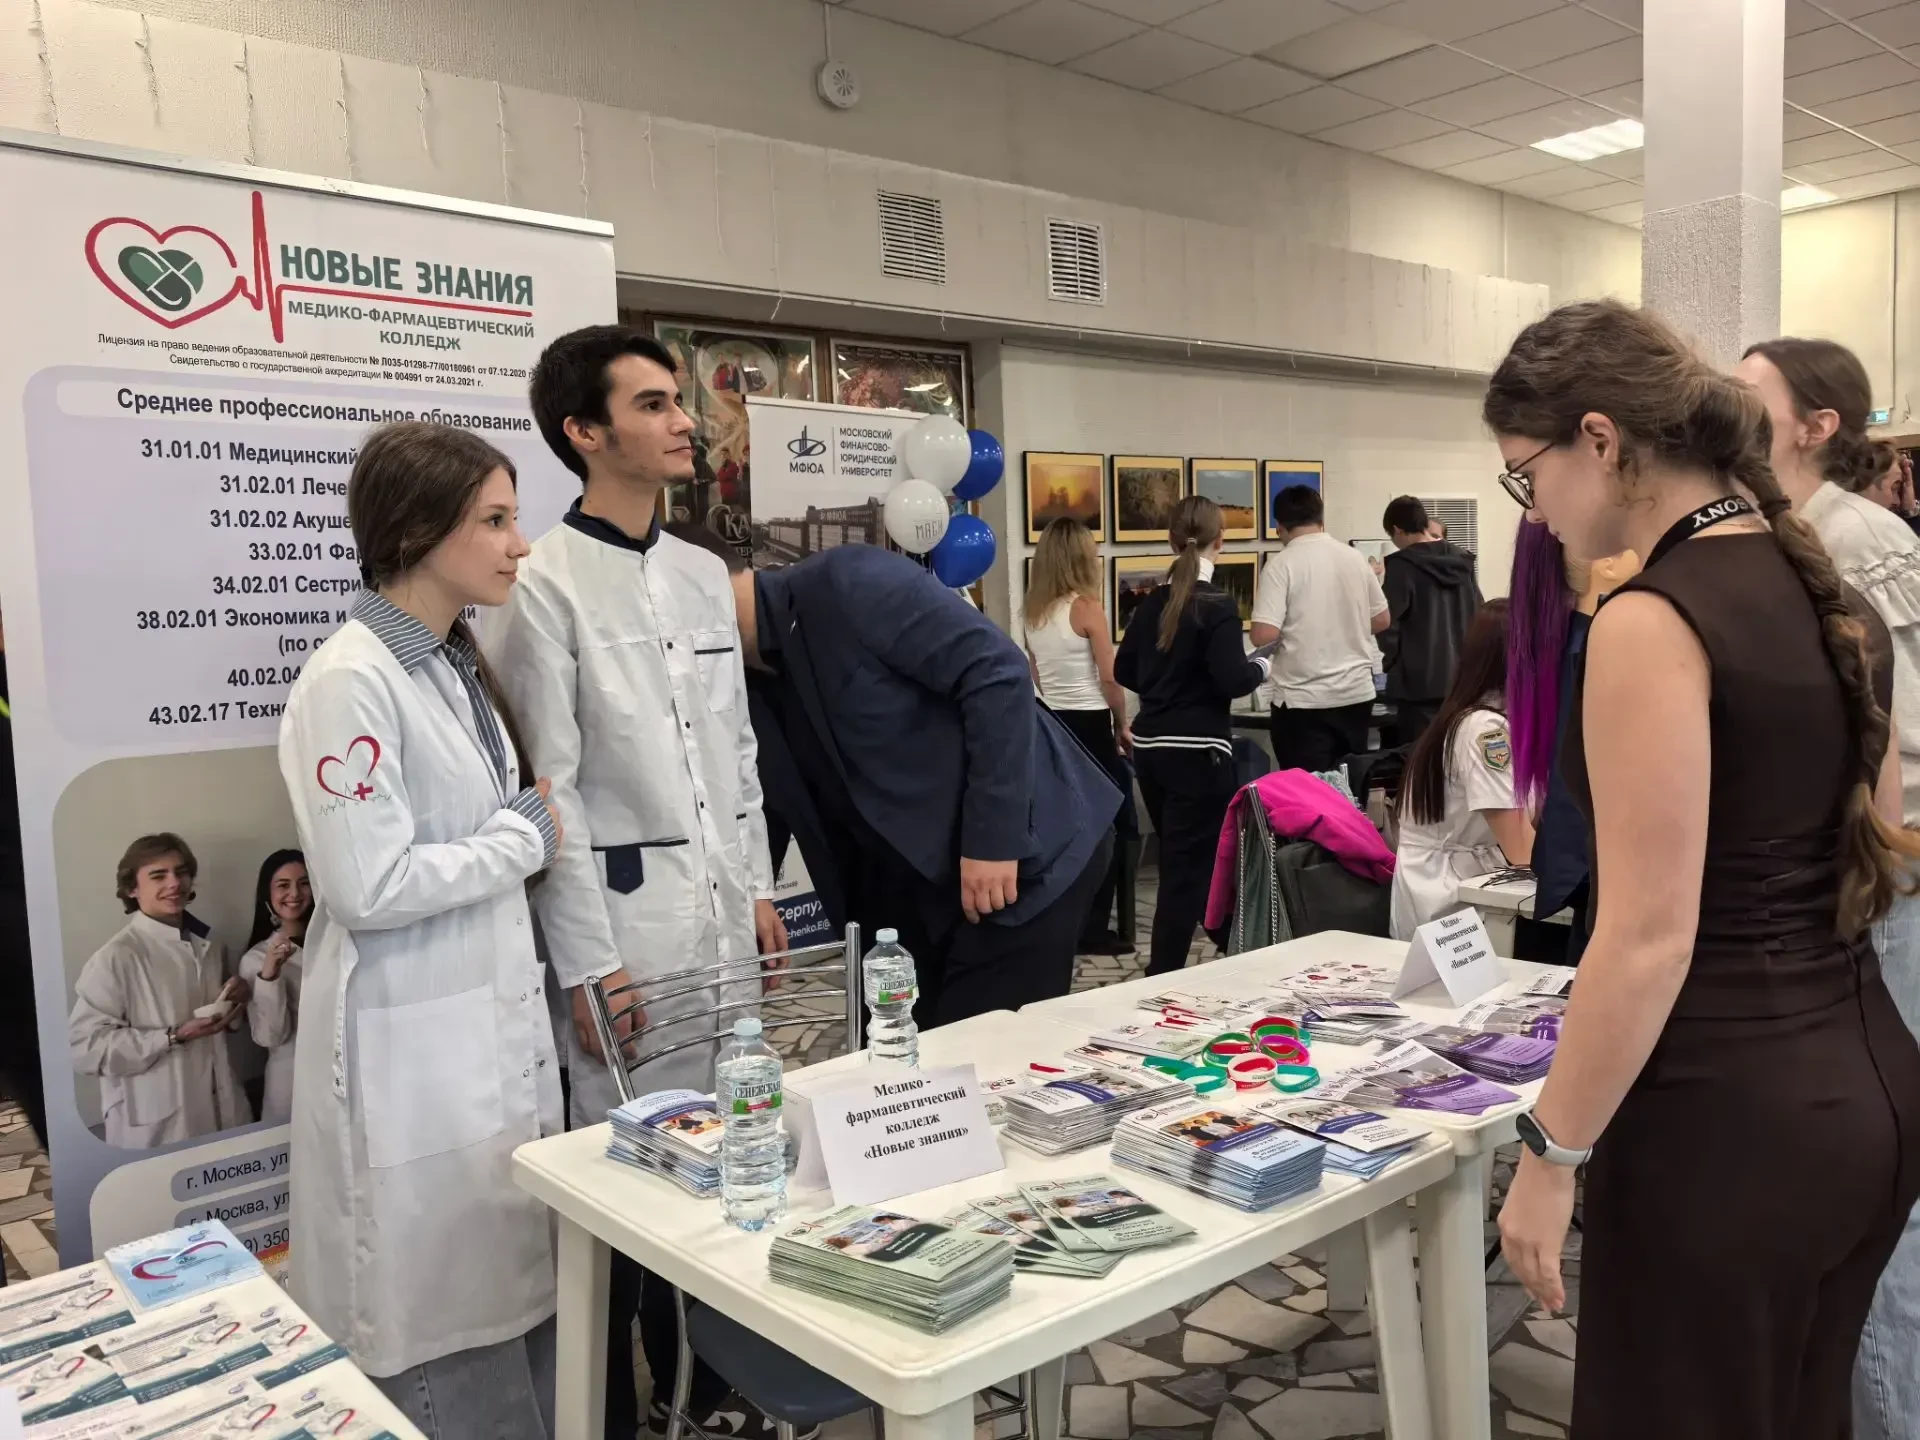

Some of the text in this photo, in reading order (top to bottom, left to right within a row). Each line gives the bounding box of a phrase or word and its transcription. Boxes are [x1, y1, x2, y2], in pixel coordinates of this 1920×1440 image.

[280, 245, 534, 306] НОВЫЕ ЗНАНИЯ
[288, 300, 535, 339] МЕДИКО-ФАРМАЦЕВТИЧЕСКИЙ
[380, 330, 462, 350] КОЛЛЕДЖ
[98, 333, 145, 347] Лицензия
[147, 339, 160, 348] на
[161, 340, 190, 352] право
[191, 343, 231, 354] ведения
[232, 344, 308, 361] образовательной
[310, 352, 368, 366] деятельности
[369, 356, 380, 366] №
[488, 366, 527, 378] 07.12.2020
[170, 353, 240, 368] Свидетельство
[250, 362, 323, 375] государственной
[324, 366, 382, 380] аккредитации
[383, 370, 393, 381] №
[394, 371, 423, 383] 004991
[435, 375, 476, 387] 24.03.2021
[477, 379, 484, 388] г.
[117, 387, 532, 431] Среднее профессиональное образование
[839, 427, 893, 440] МОСКОВСКИЙ
[140, 438, 359, 466] 31.01.01 Медицинский
[840, 440, 892, 452] ФИНАНСОВО-
[789, 462, 825, 474] МФЮА
[840, 453, 898, 465] ЮРИДИЧЕСКИЙ
[840, 466, 893, 478] УНИВЕРСИТЕТ
[219, 475, 296, 495] 31.02.01
[209, 509, 288, 529] 31.02.02
[1692, 497, 1749, 529] SONY
[248, 542, 323, 561] 33.02.01
[212, 576, 289, 595] 34.02.01
[136, 607, 347, 630] 38.02.01 Экономика и
[278, 634, 308, 656] (по
[227, 666, 301, 687] 40.02.04
[148, 702, 230, 726] 43.02.17
[873, 1079, 924, 1099] Медико
[846, 1085, 968, 1127] фармацевтический
[886, 1112, 941, 1135] колледж
[863, 1126, 969, 1161] «Новые знания»
[186, 1176, 199, 1190] г.
[203, 1160, 267, 1185] Москва,
[206, 1198, 269, 1222] Москва,
